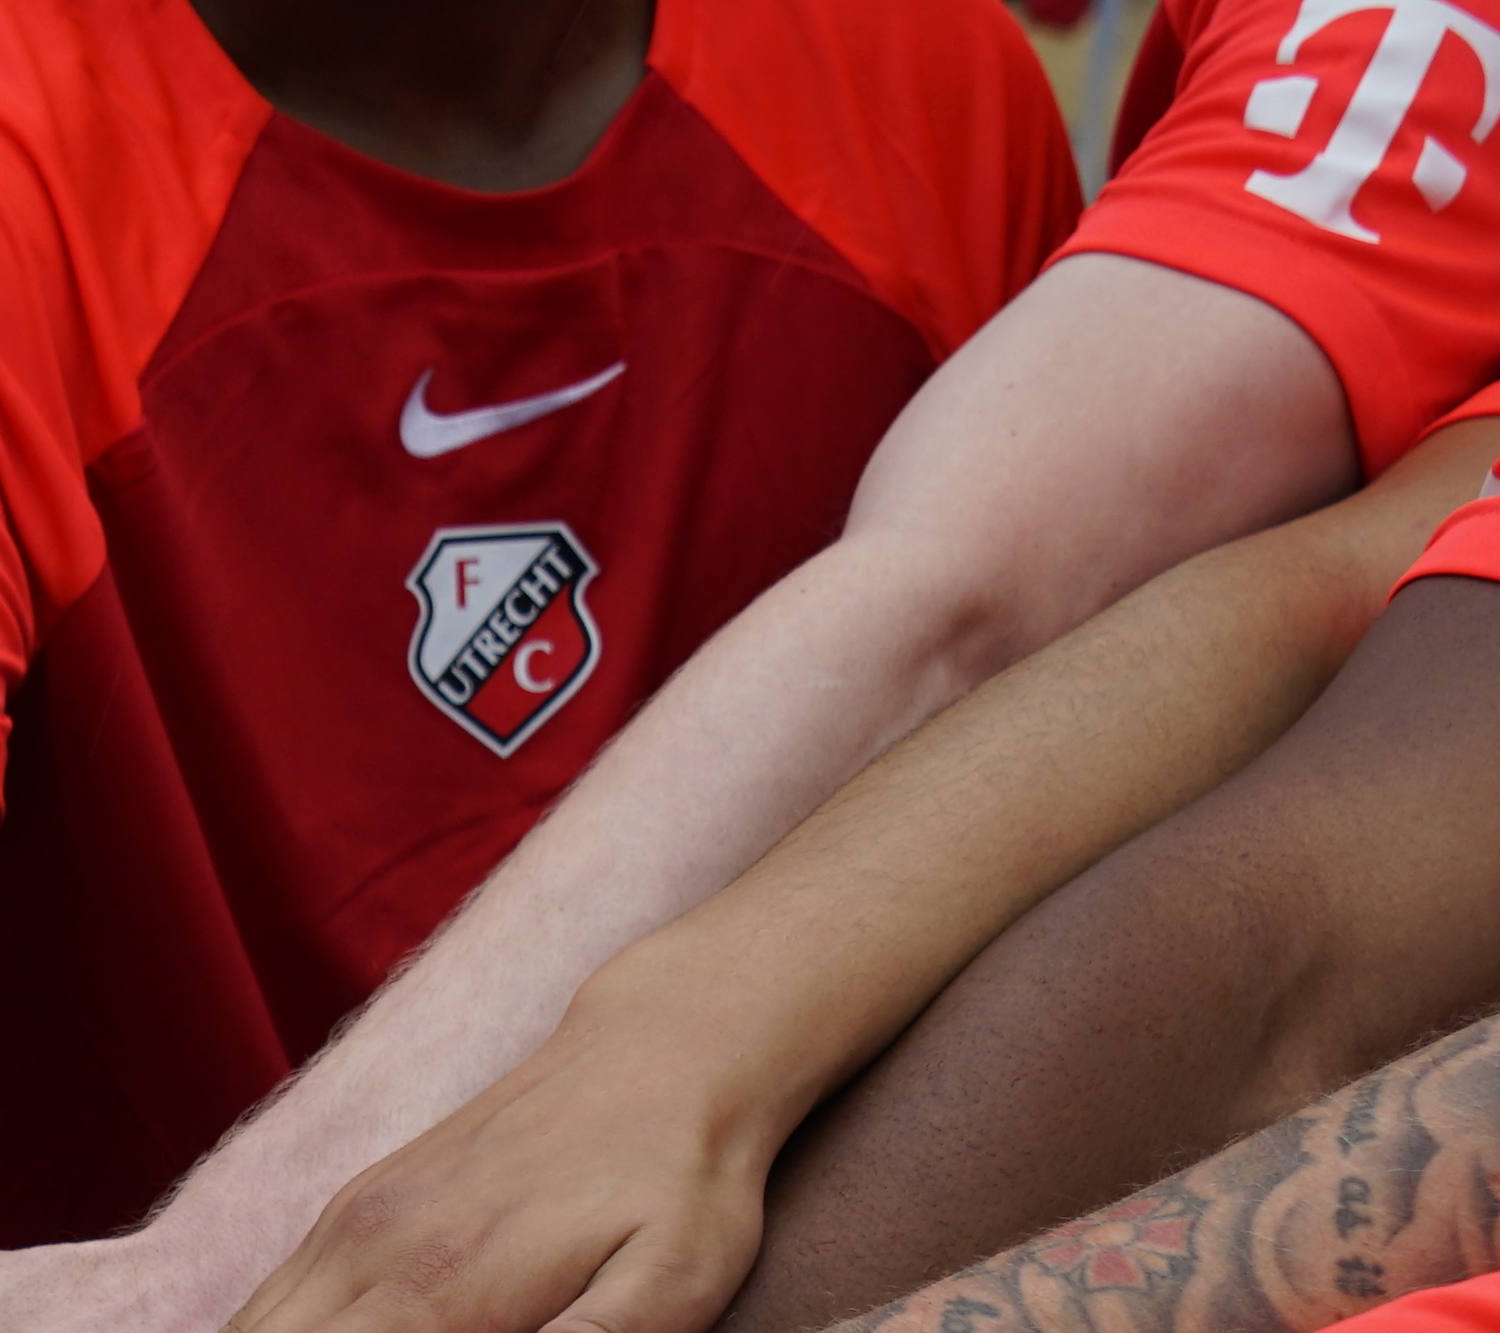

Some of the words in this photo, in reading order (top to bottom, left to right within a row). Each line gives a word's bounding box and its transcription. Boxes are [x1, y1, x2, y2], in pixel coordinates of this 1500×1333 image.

[455, 556, 479, 608] F
[436, 544, 577, 706] UTRECHT
[512, 638, 556, 694] C
